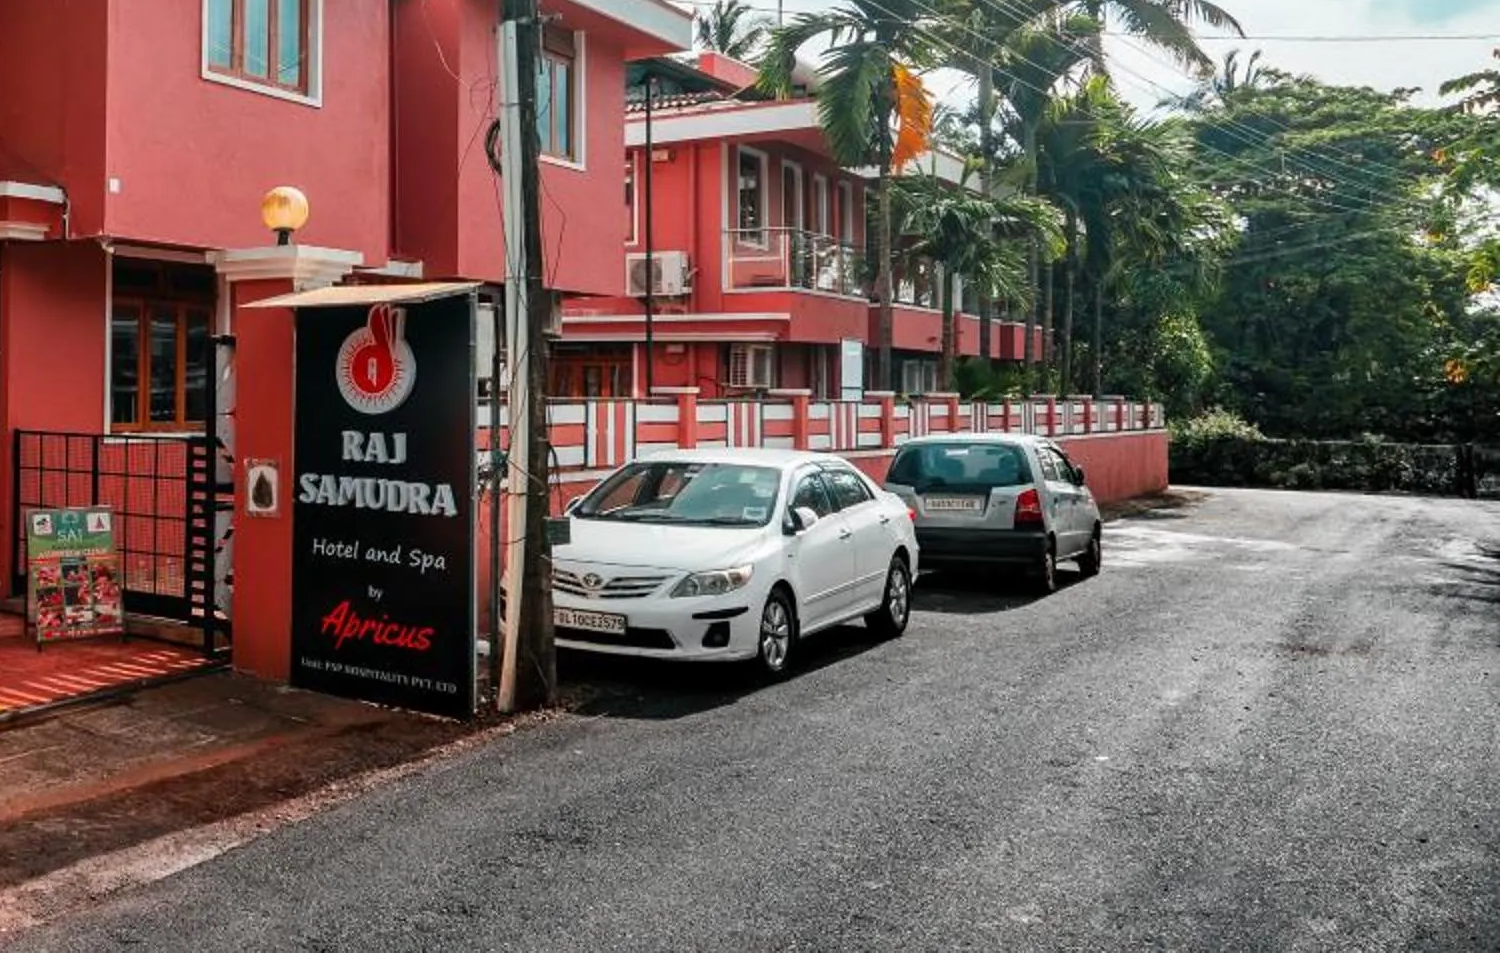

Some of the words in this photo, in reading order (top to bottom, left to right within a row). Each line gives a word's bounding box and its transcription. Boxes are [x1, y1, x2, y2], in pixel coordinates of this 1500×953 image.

[341, 430, 407, 464] RAJ
[299, 473, 458, 517] SAMUDRA
[313, 538, 359, 560] Hotel
[365, 545, 401, 564] and
[409, 549, 446, 574] Spa
[368, 585, 383, 601] by
[322, 600, 436, 650] Apricus
